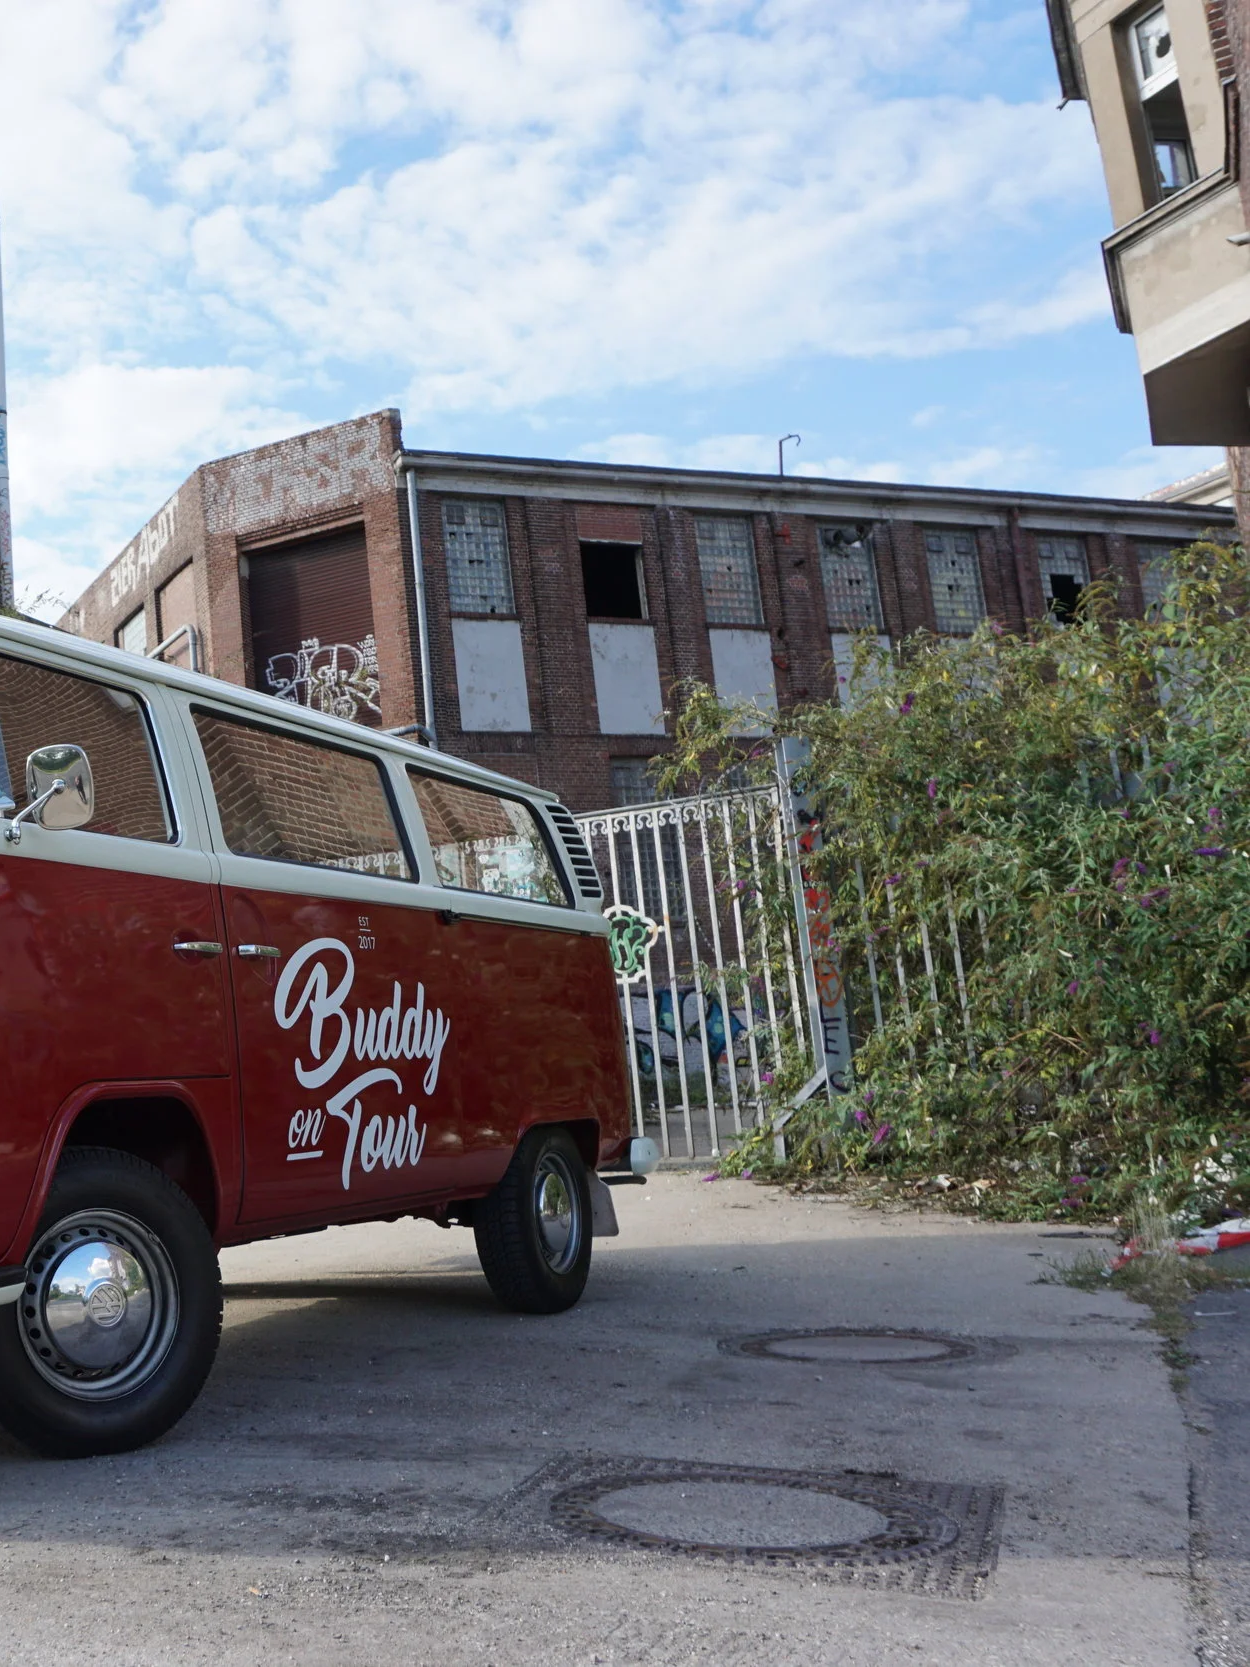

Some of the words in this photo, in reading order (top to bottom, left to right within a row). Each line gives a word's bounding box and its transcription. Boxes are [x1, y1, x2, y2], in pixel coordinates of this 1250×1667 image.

[358, 916, 369, 927] EST
[358, 935, 376, 950] 2017
[274, 937, 450, 1095] Buddy
[288, 1108, 326, 1148] on
[326, 1067, 427, 1190] Tour
